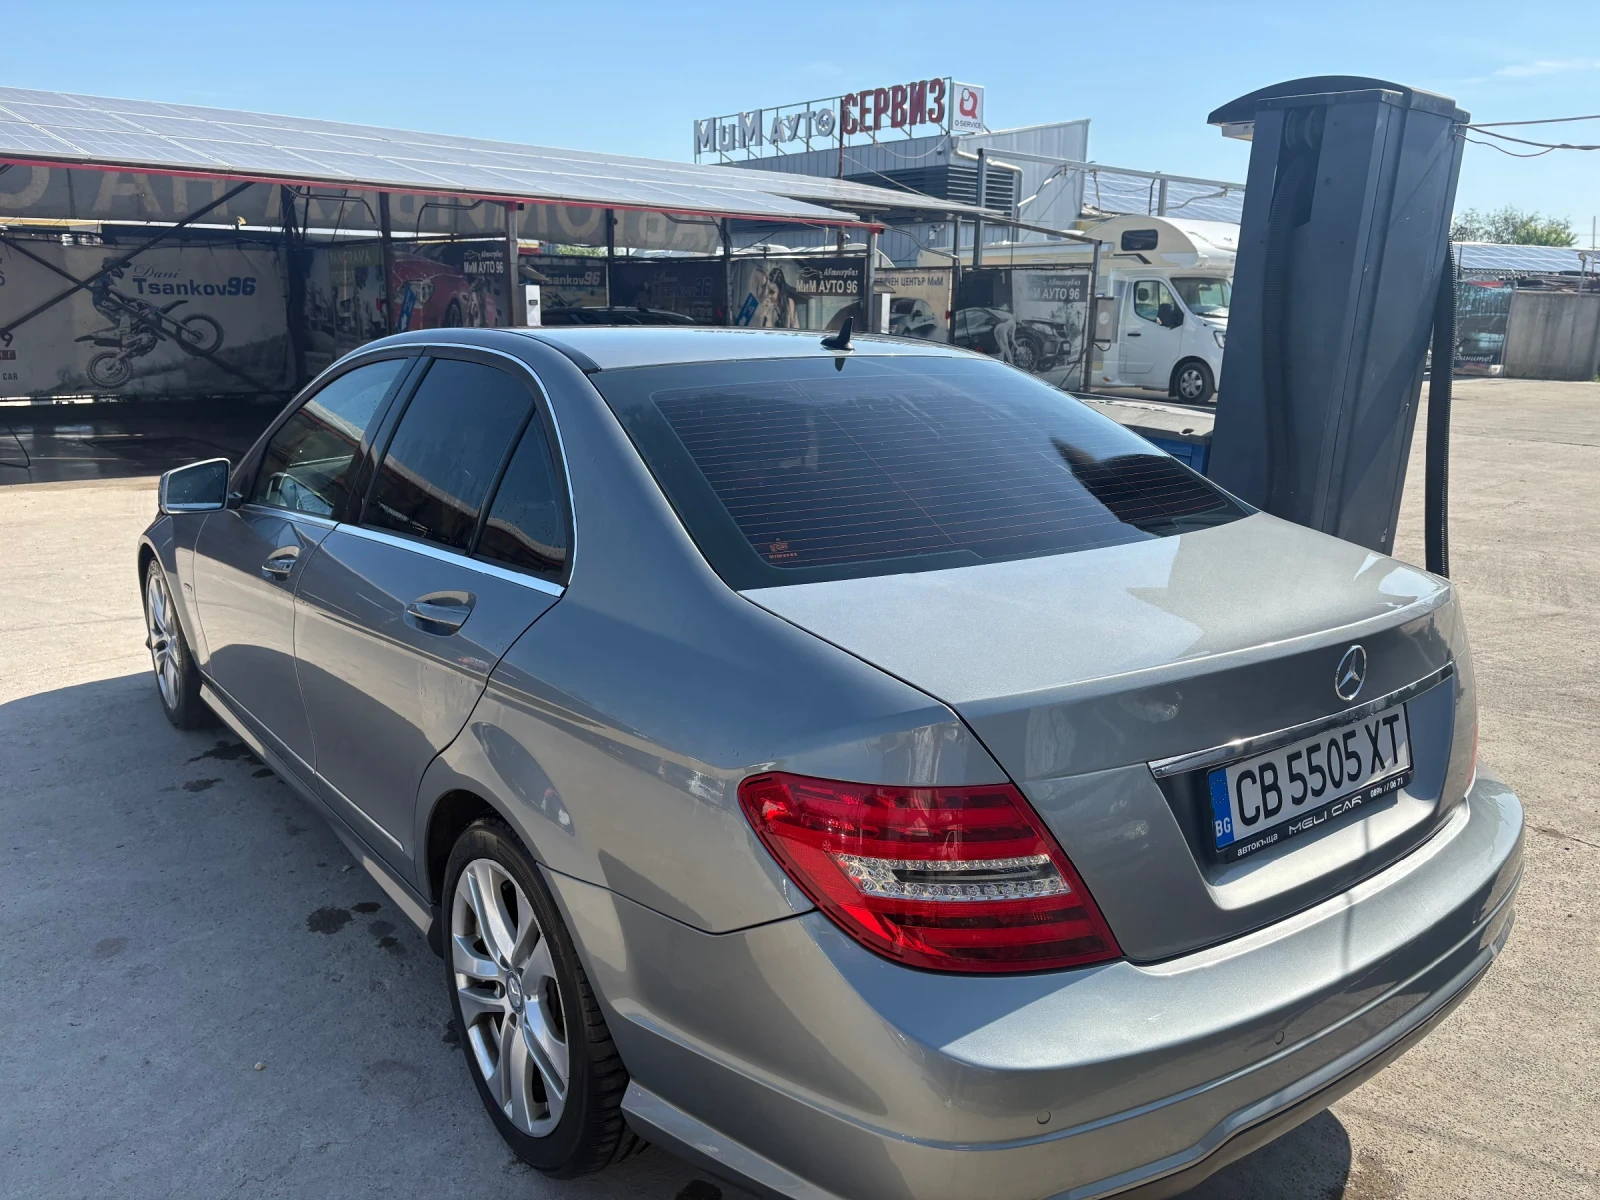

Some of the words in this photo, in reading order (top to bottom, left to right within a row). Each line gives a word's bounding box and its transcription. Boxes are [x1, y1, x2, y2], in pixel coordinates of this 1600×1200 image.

[842, 78, 946, 135] СЕРВИЗ
[960, 120, 982, 129] SERVICE
[479, 261, 495, 273] АУТО
[496, 261, 504, 273] 96
[818, 280, 844, 293] АУТО
[847, 280, 858, 293] 96
[901, 277, 925, 287] ЦЕНТЪР
[1042, 288, 1067, 299] АУТО
[1069, 288, 1080, 299] 96
[3, 372, 18, 381] CAR
[1289, 813, 1327, 835] MELI
[1332, 796, 1362, 817] CAR
[1215, 817, 1232, 838] BG
